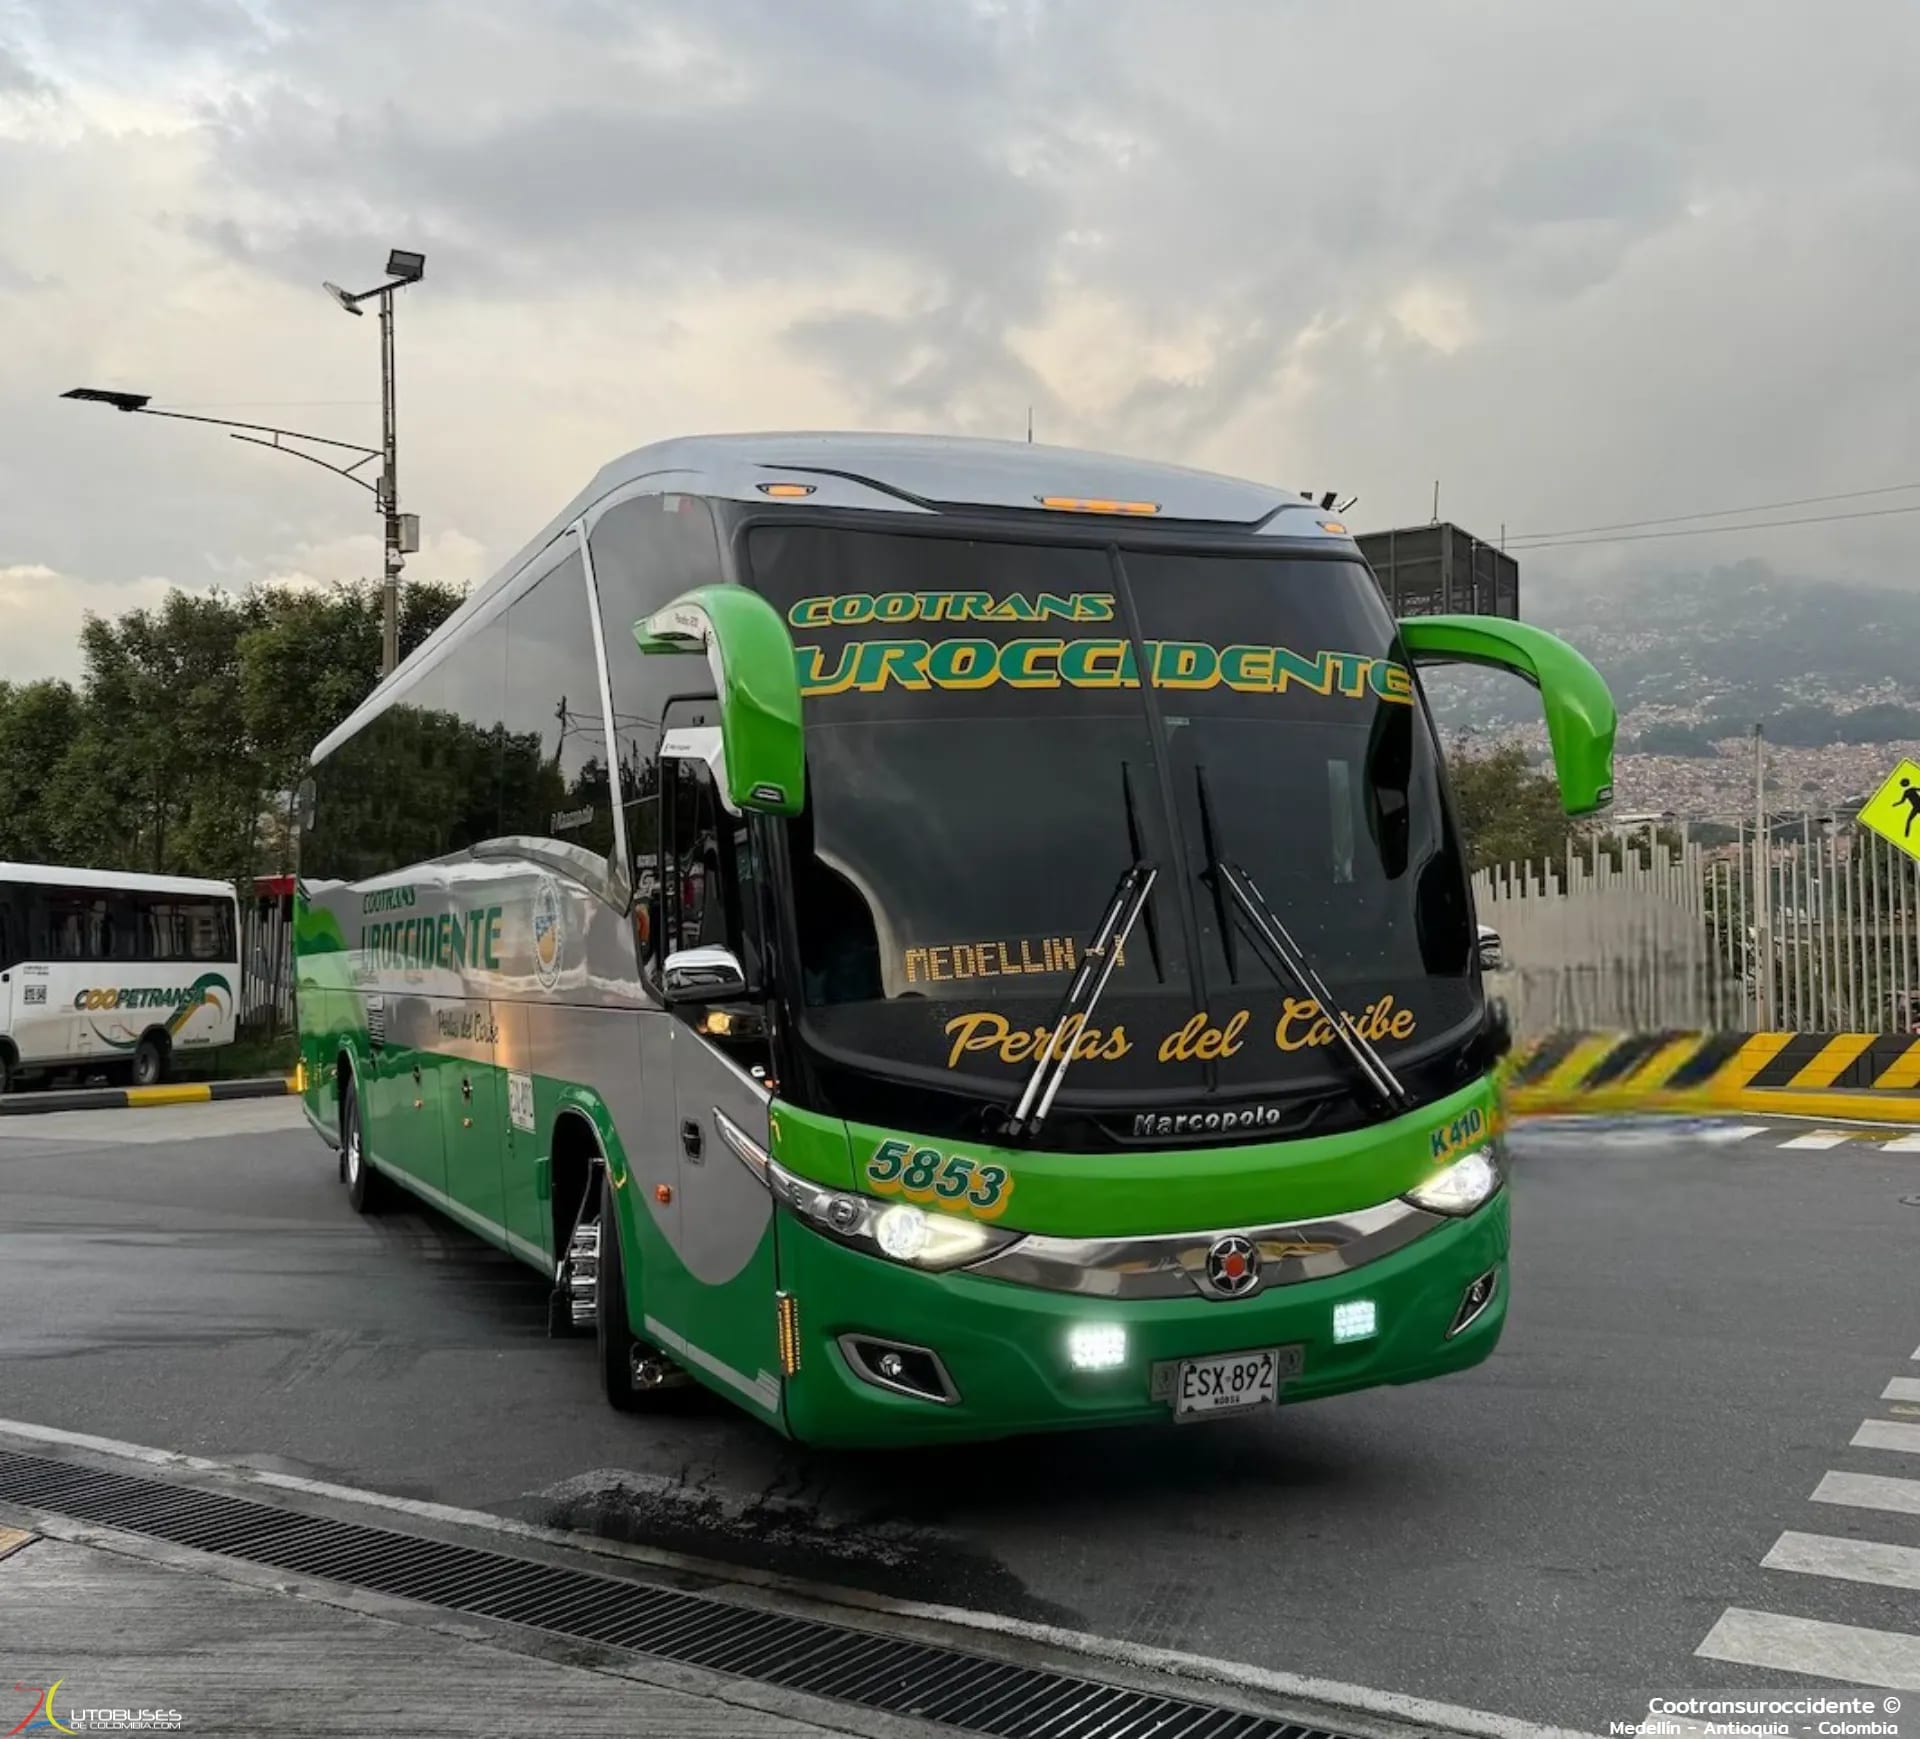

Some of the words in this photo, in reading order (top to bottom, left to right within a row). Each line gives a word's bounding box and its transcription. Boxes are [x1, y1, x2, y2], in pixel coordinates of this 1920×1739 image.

[787, 590, 1115, 628] COOTRANS
[362, 884, 416, 914] COOTRANS
[904, 937, 1077, 983] MEDELLIN
[944, 1011, 1133, 1069] Perlas
[1157, 1008, 1251, 1063] del
[1275, 994, 1417, 1052] Caribe
[1132, 1105, 1282, 1137] Marcopolo
[867, 1138, 1012, 1214] 5853
